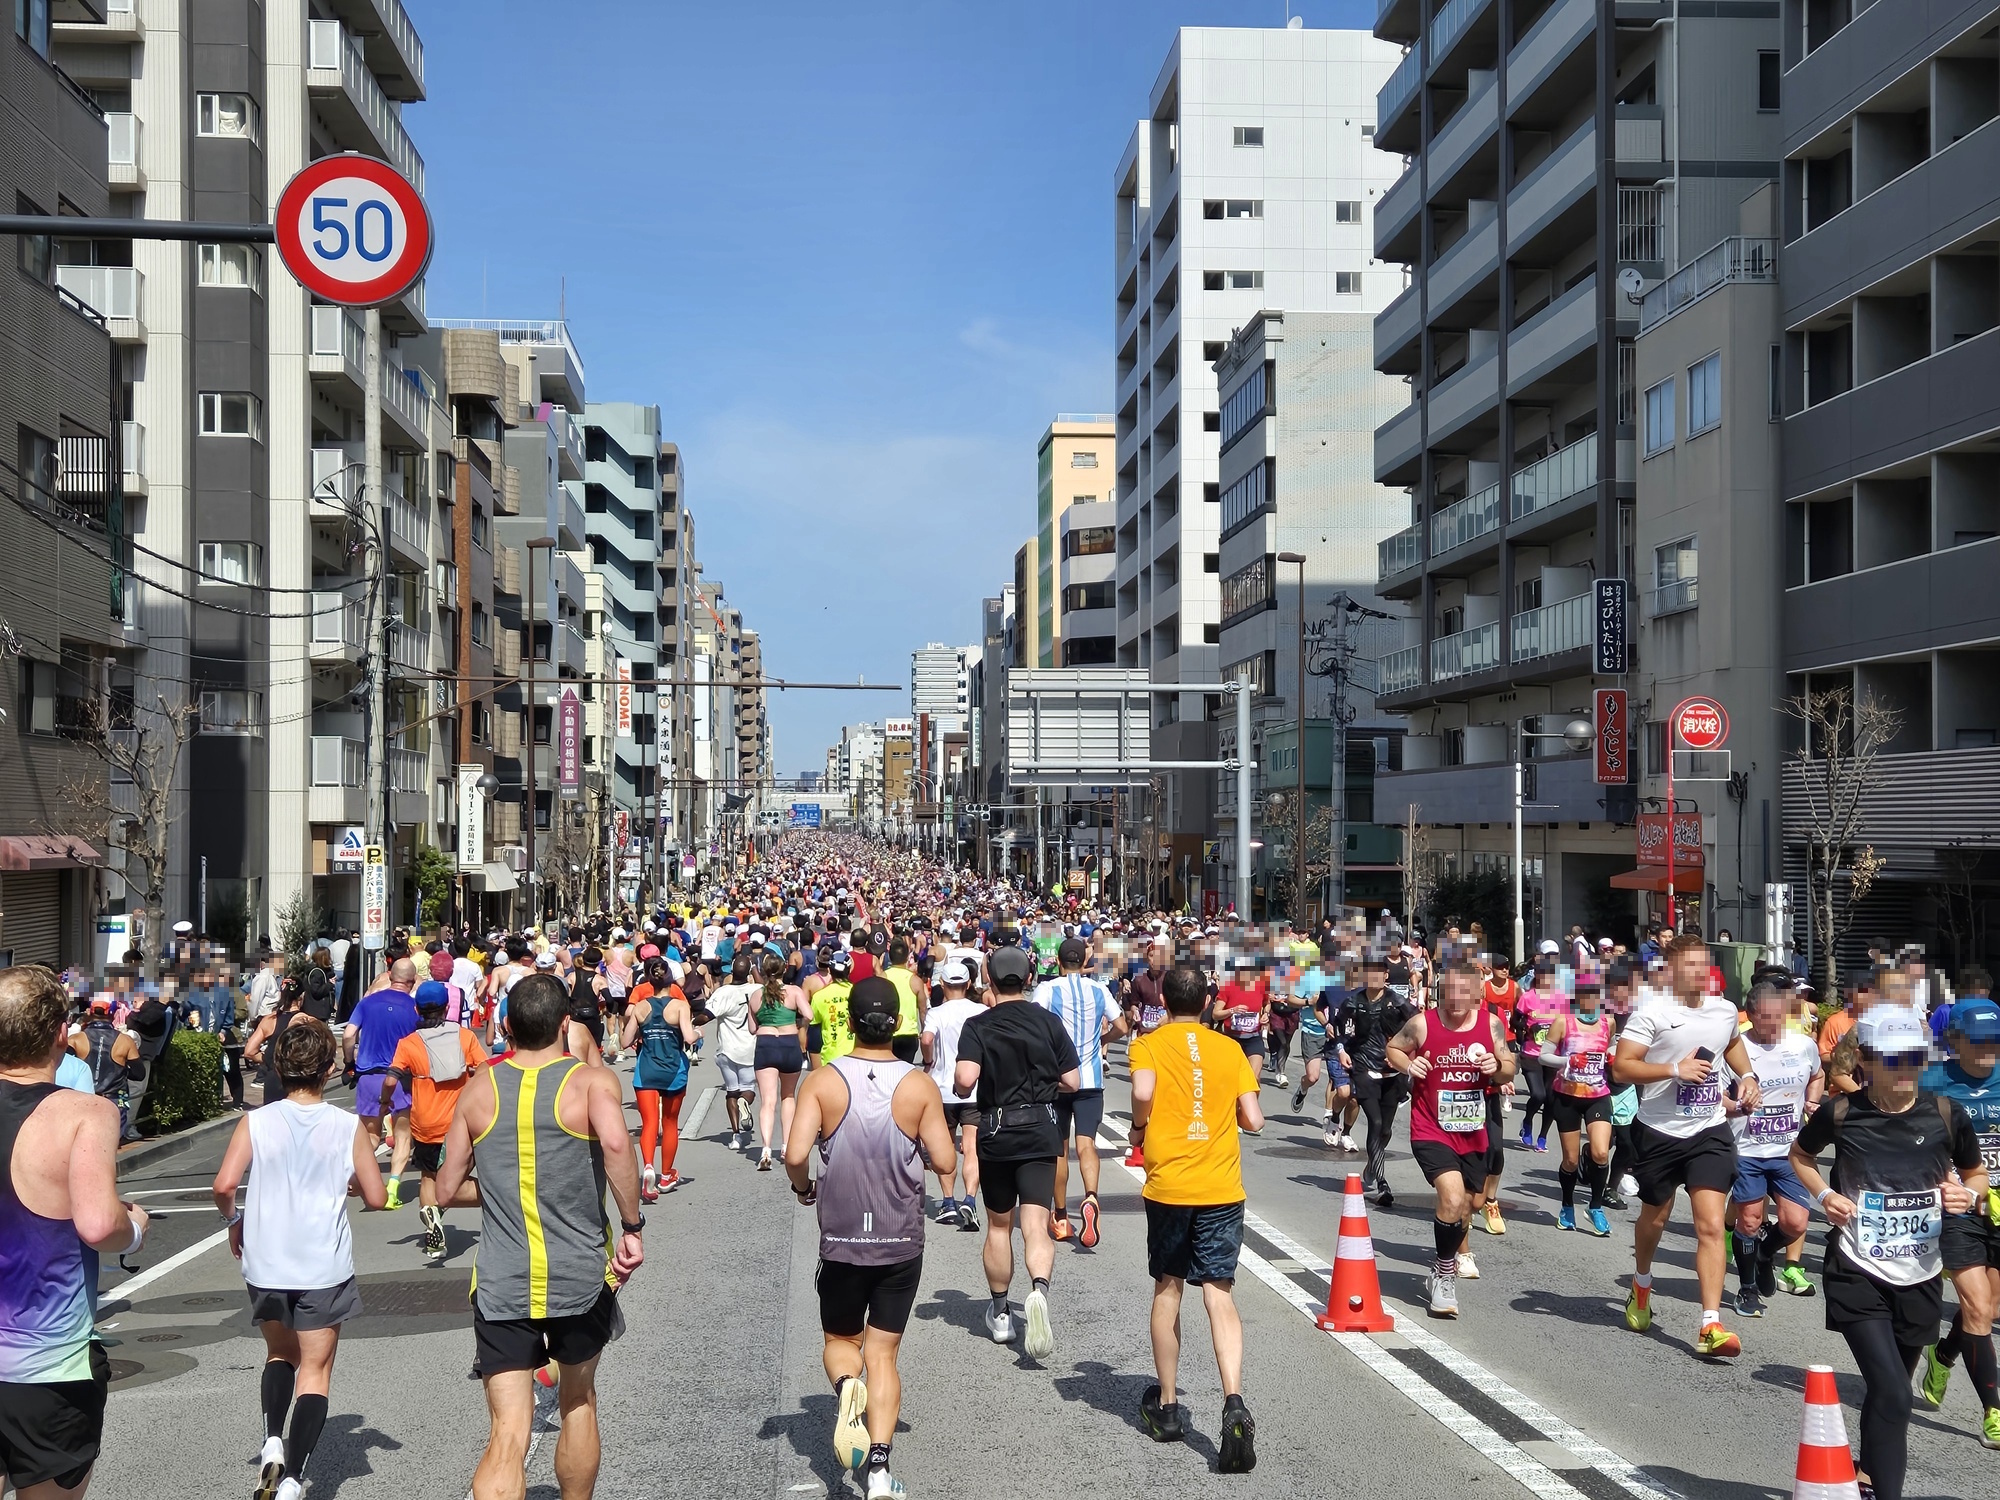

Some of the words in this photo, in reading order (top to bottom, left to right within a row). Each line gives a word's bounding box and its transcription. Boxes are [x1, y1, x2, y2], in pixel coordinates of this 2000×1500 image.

[313, 197, 393, 262] 50
[1602, 585, 1614, 669] はっぴいたいむ
[619, 666, 630, 729] JANOME
[1602, 695, 1621, 771] もんじゃ
[1683, 717, 1718, 734] 消火栓
[564, 705, 575, 780] 不動産の相談室
[367, 848, 381, 865] P
[1070, 872, 1085, 883] 22
[1187, 1032, 1200, 1062] RUNS
[1193, 1069, 1203, 1098] INTO
[1441, 1071, 1480, 1083] JASON
[1194, 1101, 1203, 1118] KK
[1451, 1104, 1480, 1118] 13232
[1760, 1116, 1792, 1132] 27631
[1980, 1151, 2000, 1169] 55
[1887, 1196, 1933, 1208] 東京メトロ
[1861, 1215, 1872, 1227] E
[1878, 1213, 1930, 1237] 33306
[1863, 1233, 1870, 1242] 2
